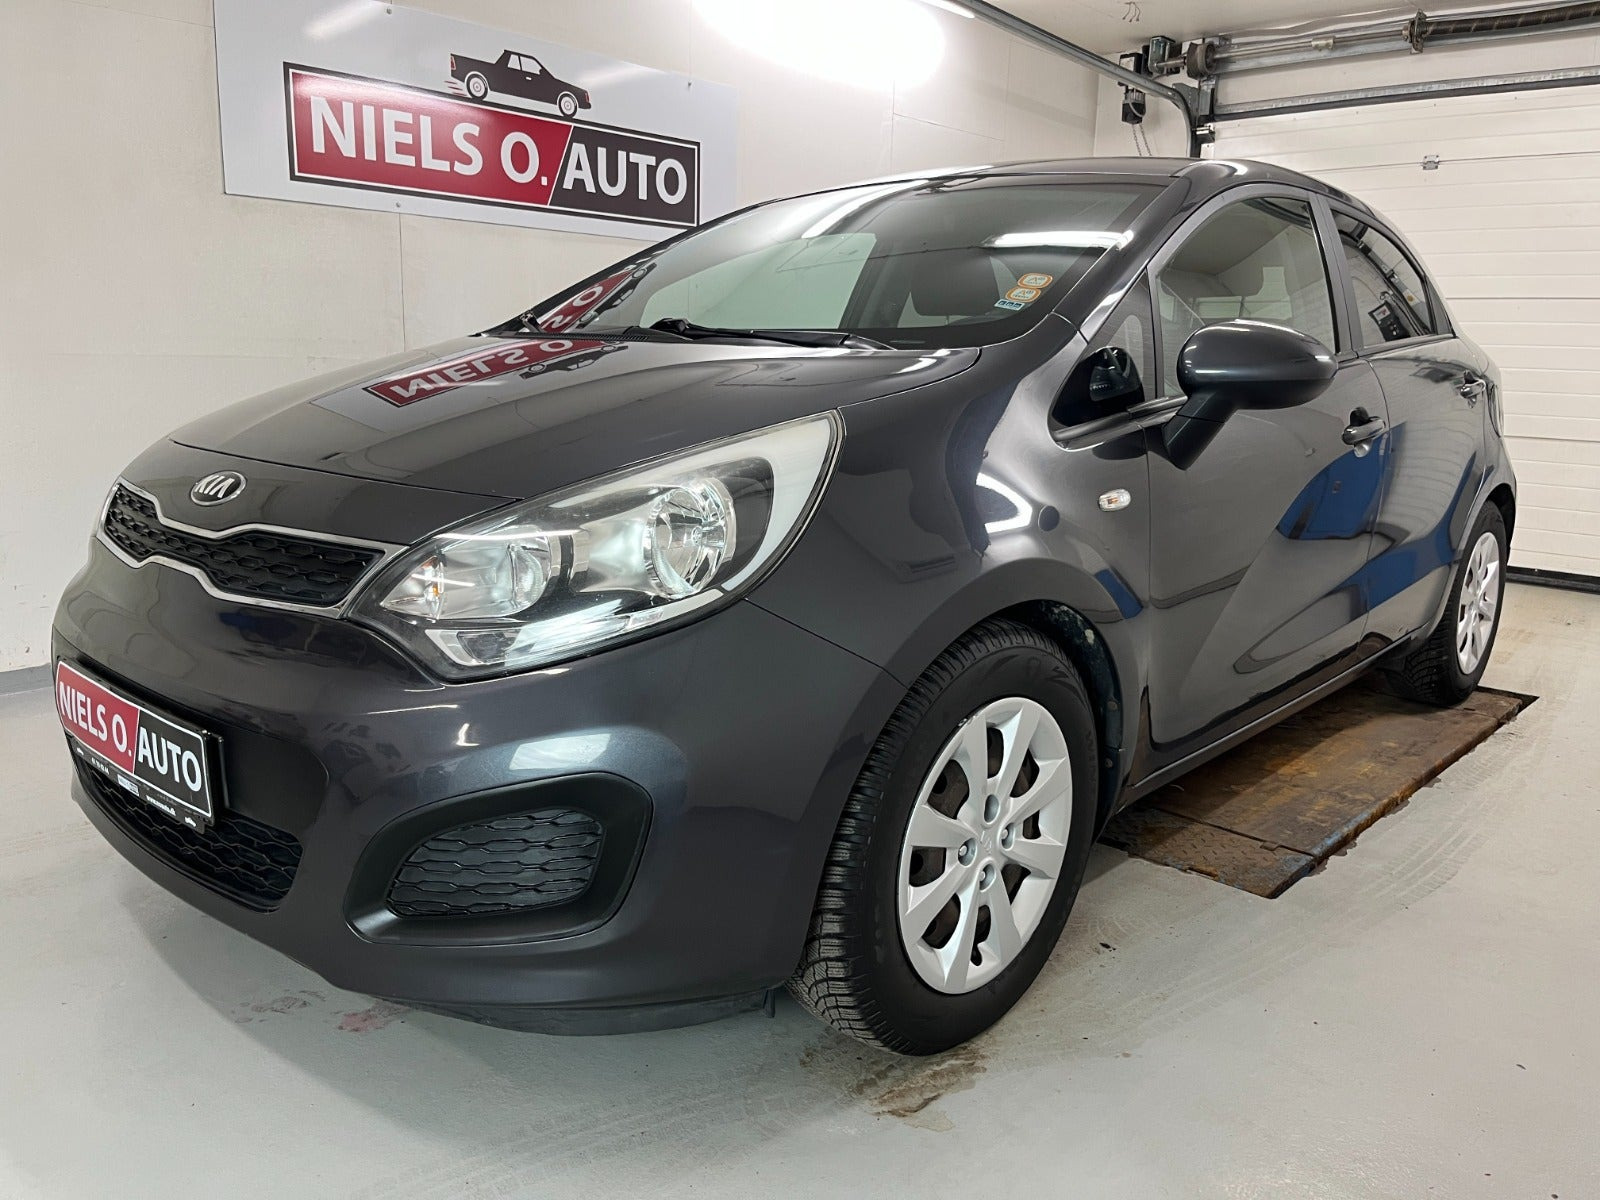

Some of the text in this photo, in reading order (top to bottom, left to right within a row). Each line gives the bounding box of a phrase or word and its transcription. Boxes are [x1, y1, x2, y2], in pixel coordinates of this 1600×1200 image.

[311, 96, 687, 204] NIELS O. AUTO
[59, 682, 201, 791] NIELS O. AUTO
